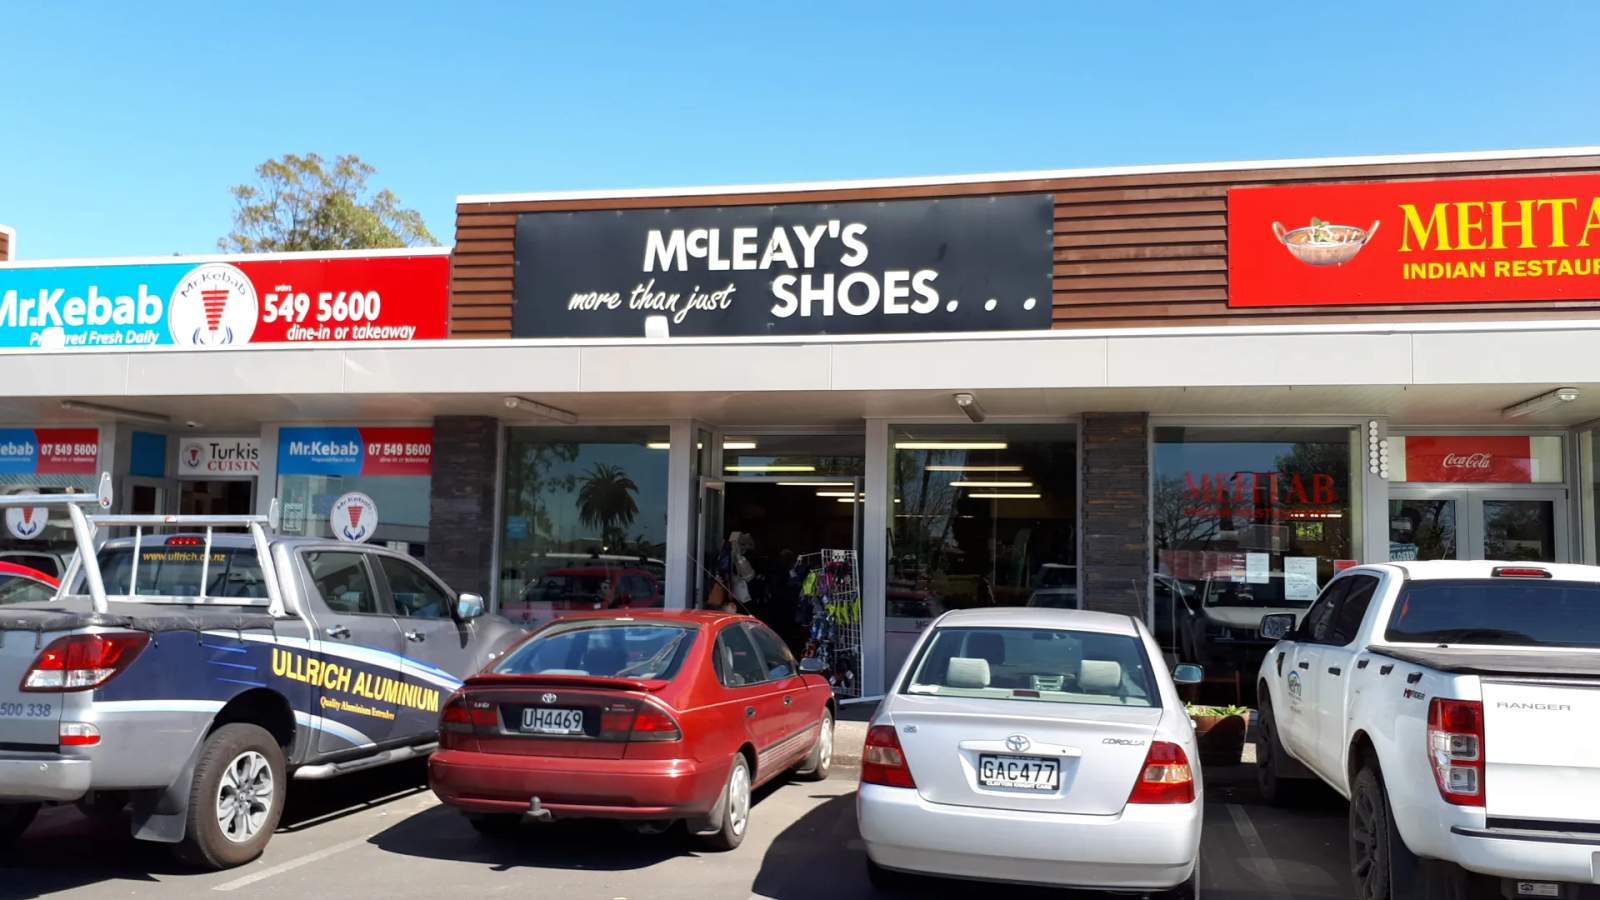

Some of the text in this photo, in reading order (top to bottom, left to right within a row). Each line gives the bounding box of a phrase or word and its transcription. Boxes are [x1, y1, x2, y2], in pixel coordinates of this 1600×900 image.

[1403, 261, 1485, 279] INDIAN
[263, 291, 381, 323] 549 5600
[568, 291, 622, 311] more
[629, 278, 680, 312] than
[673, 283, 736, 324] just
[30, 329, 160, 346] Pred Fresh Daily
[287, 324, 416, 341] dine-in or takeaway
[0, 441, 97, 456] ebab 07 549 5600
[209, 442, 259, 460] Turkis
[289, 441, 432, 456] Mr.Kebab 07 549 5600
[1184, 470, 1337, 504] MEHTAB
[143, 551, 226, 561] www.ullrich.c.nz
[272, 648, 440, 713] ULLRICH ALUMINIUM
[0, 702, 52, 717] 500 338
[1497, 702, 1571, 711] RANGER
[523, 709, 582, 729] UH4469
[984, 760, 1056, 783] GAC477
